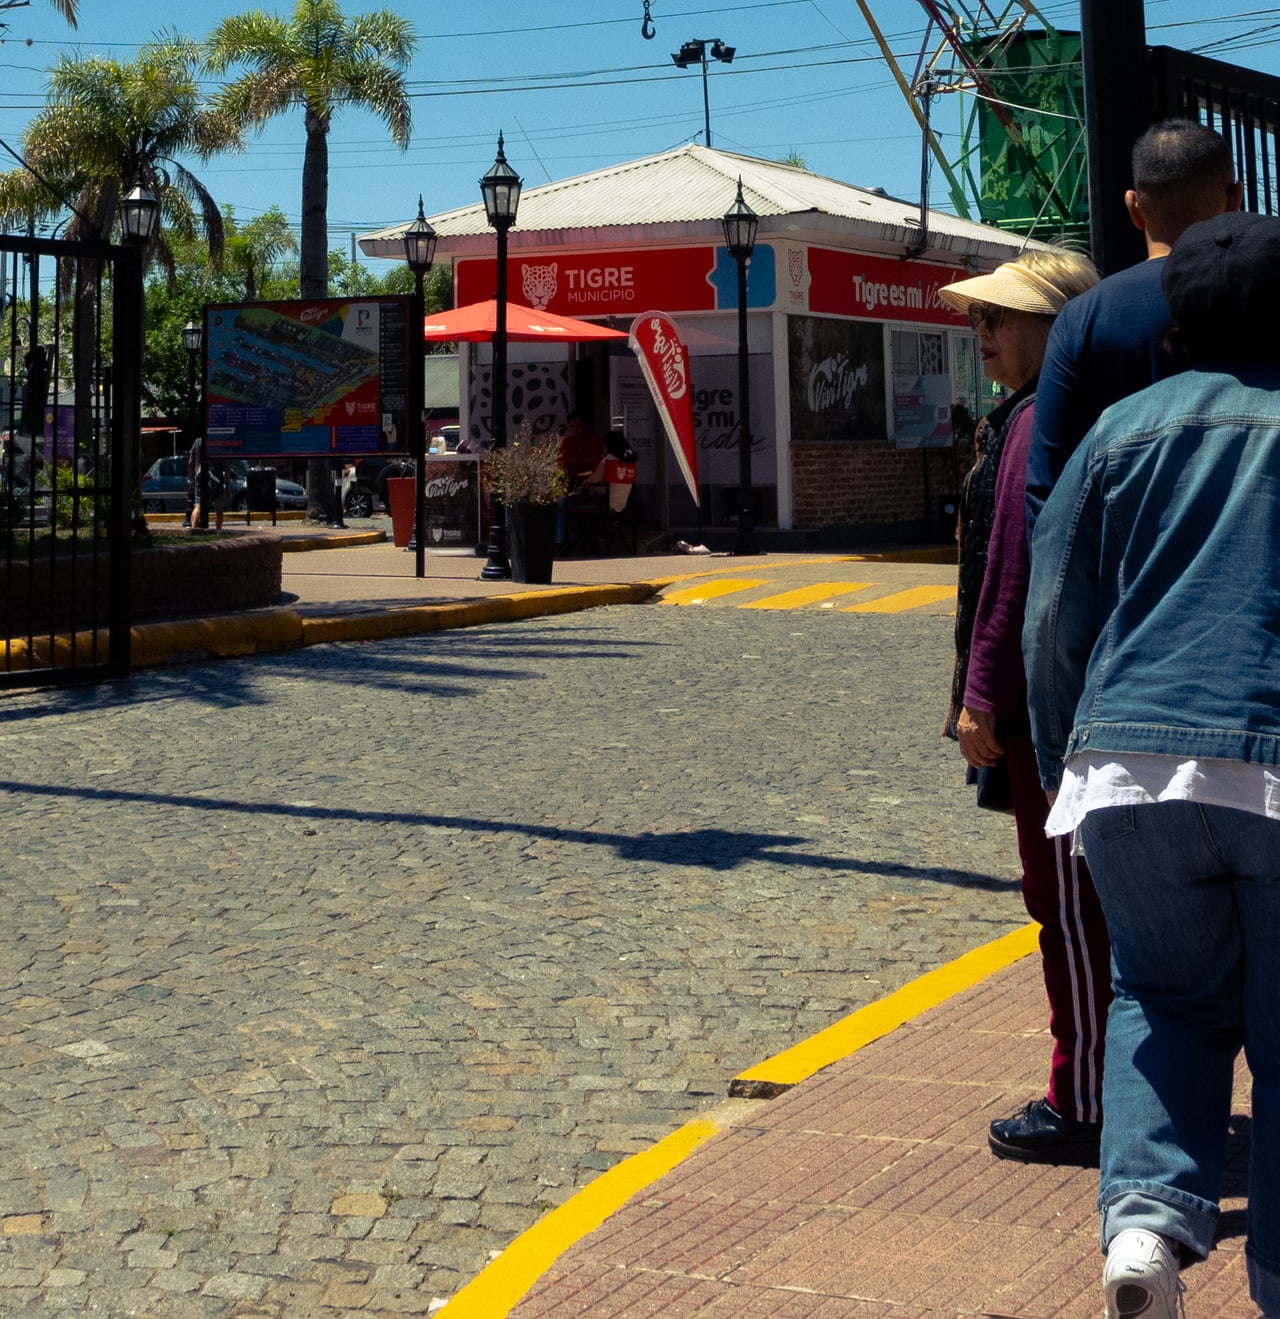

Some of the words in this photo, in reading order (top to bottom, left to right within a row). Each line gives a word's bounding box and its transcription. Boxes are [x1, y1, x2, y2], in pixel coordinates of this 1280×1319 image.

[564, 266, 635, 289] TIGRE
[567, 288, 635, 304] MUNICIPIO
[789, 290, 805, 301] TIGRE
[852, 273, 887, 311] Tigre
[889, 286, 905, 307] es
[907, 280, 922, 309] mi
[692, 384, 733, 411] igre
[442, 529, 462, 537] TIGRE
